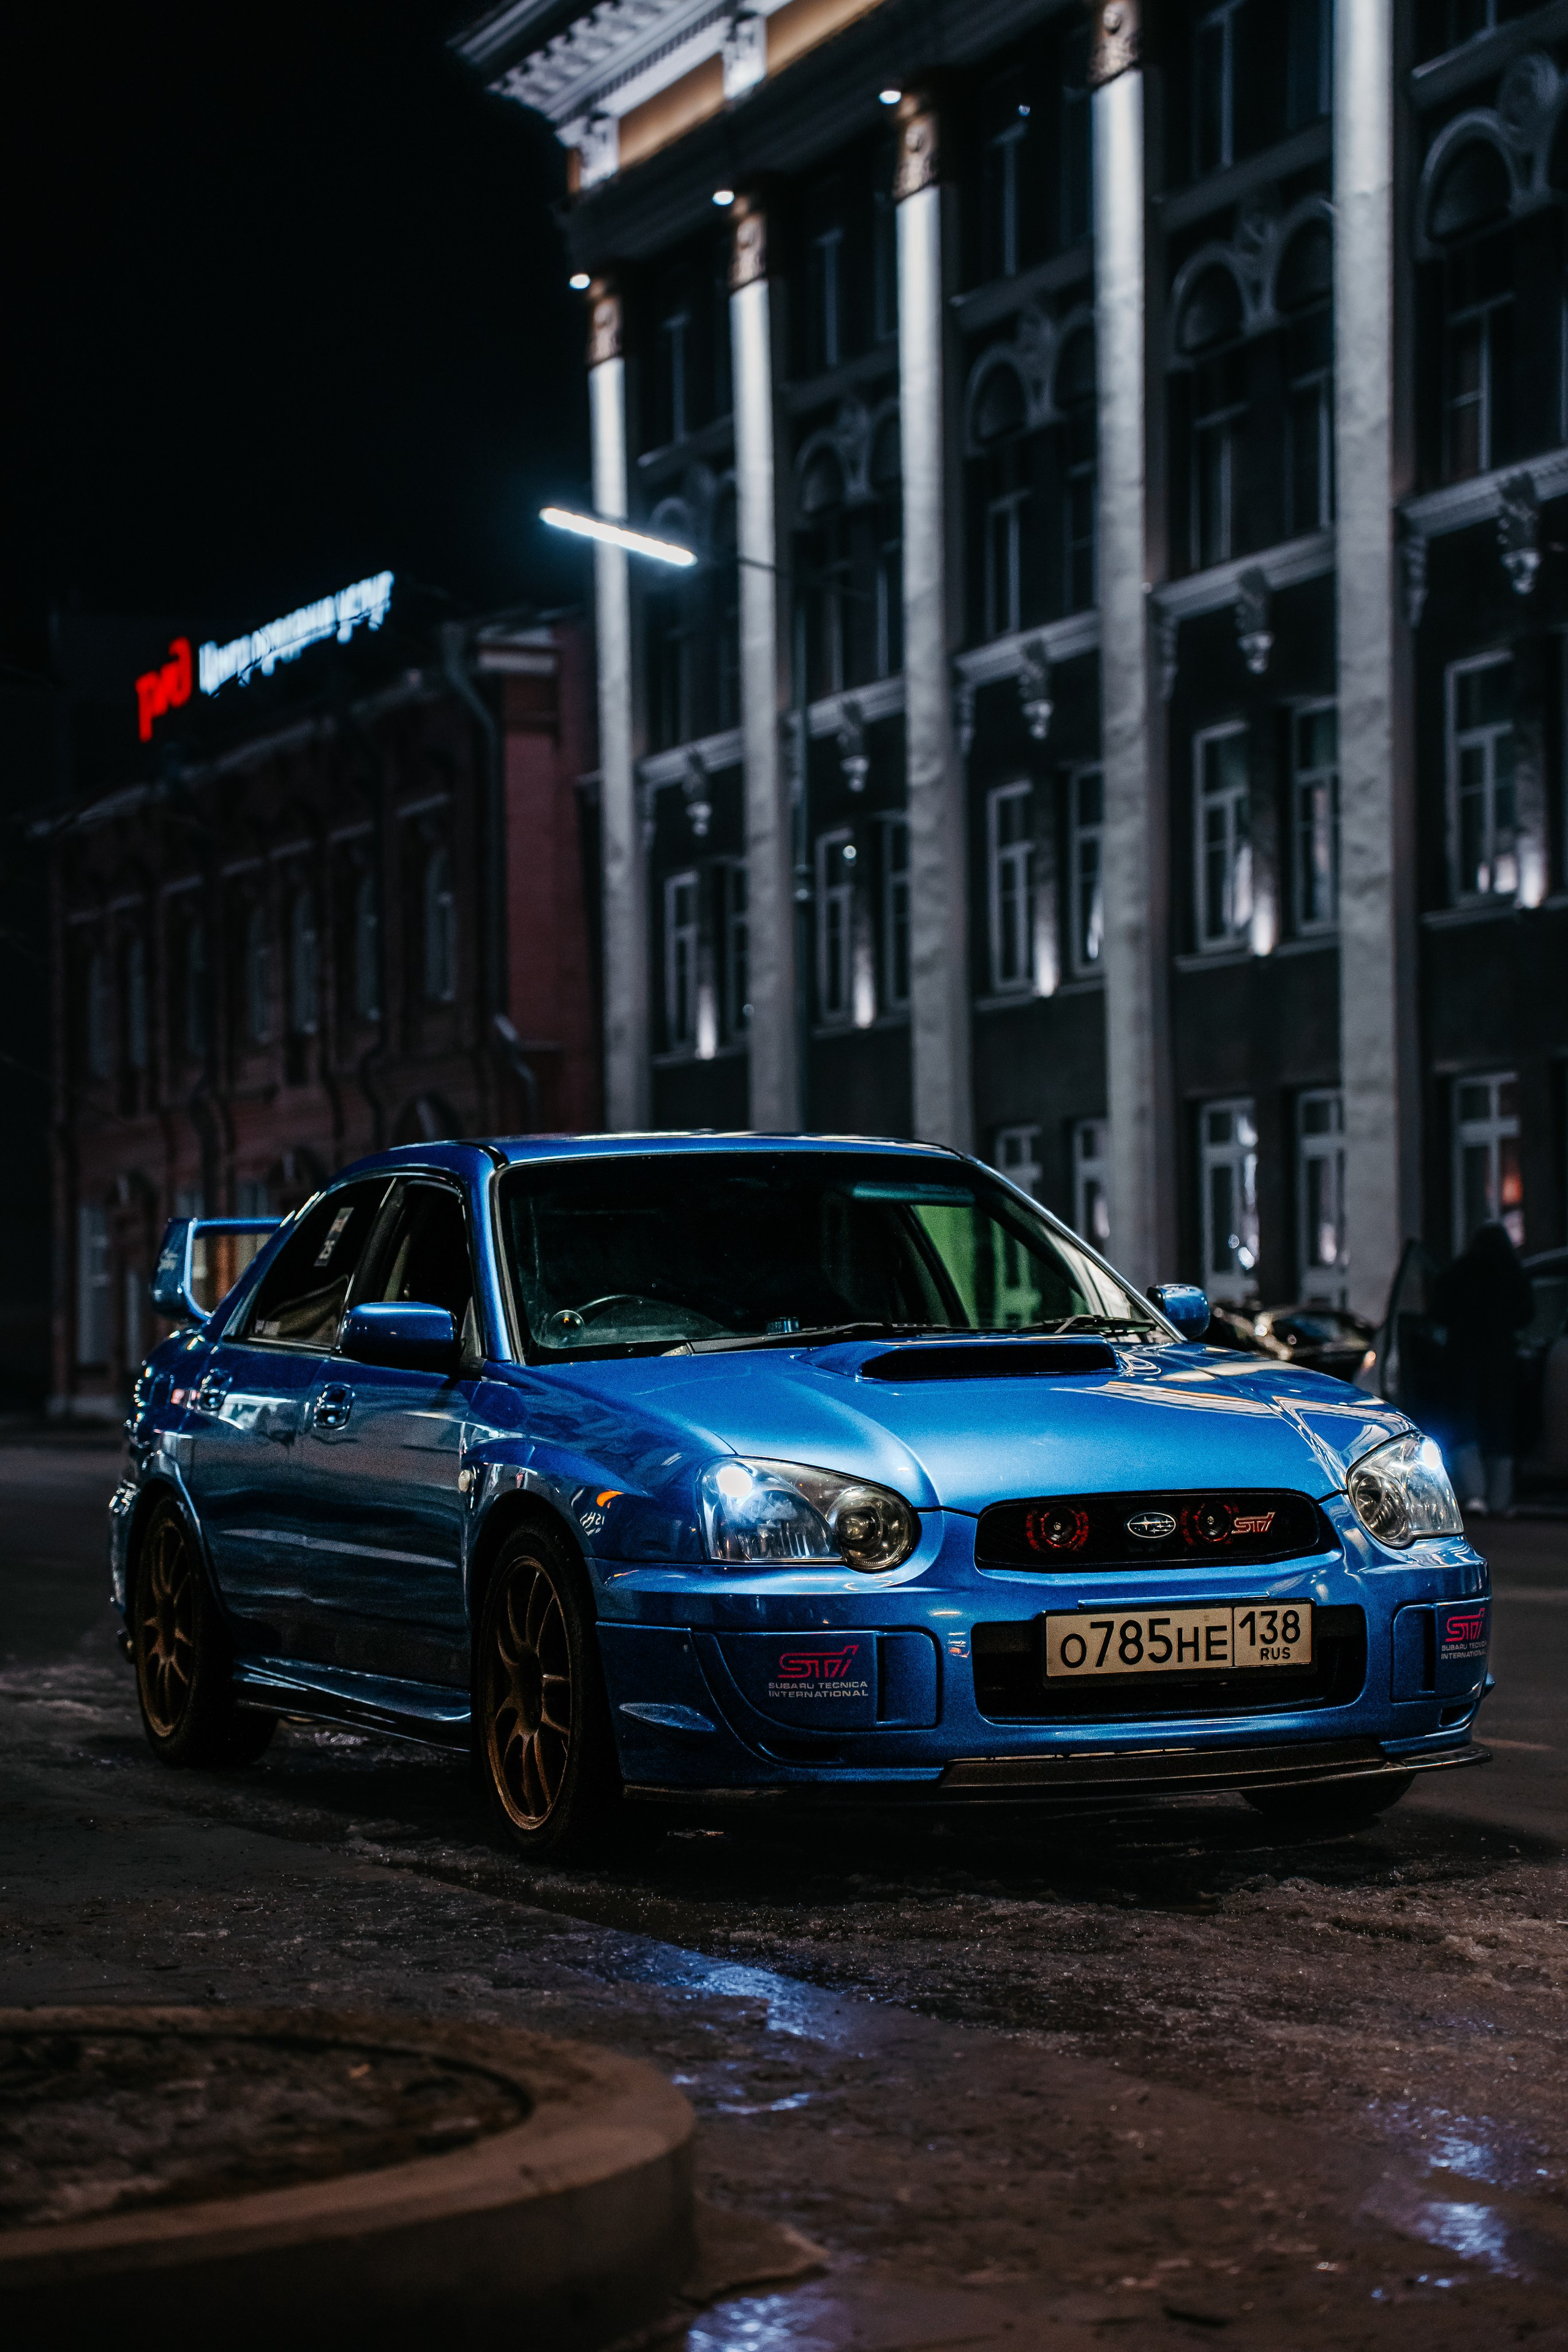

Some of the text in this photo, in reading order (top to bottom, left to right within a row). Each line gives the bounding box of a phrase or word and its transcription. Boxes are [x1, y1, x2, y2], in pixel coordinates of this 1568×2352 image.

[1238, 1609, 1302, 1646] 138
[1261, 1646, 1291, 1660] RUS
[768, 1689, 869, 1698] INTERNATIONAL
